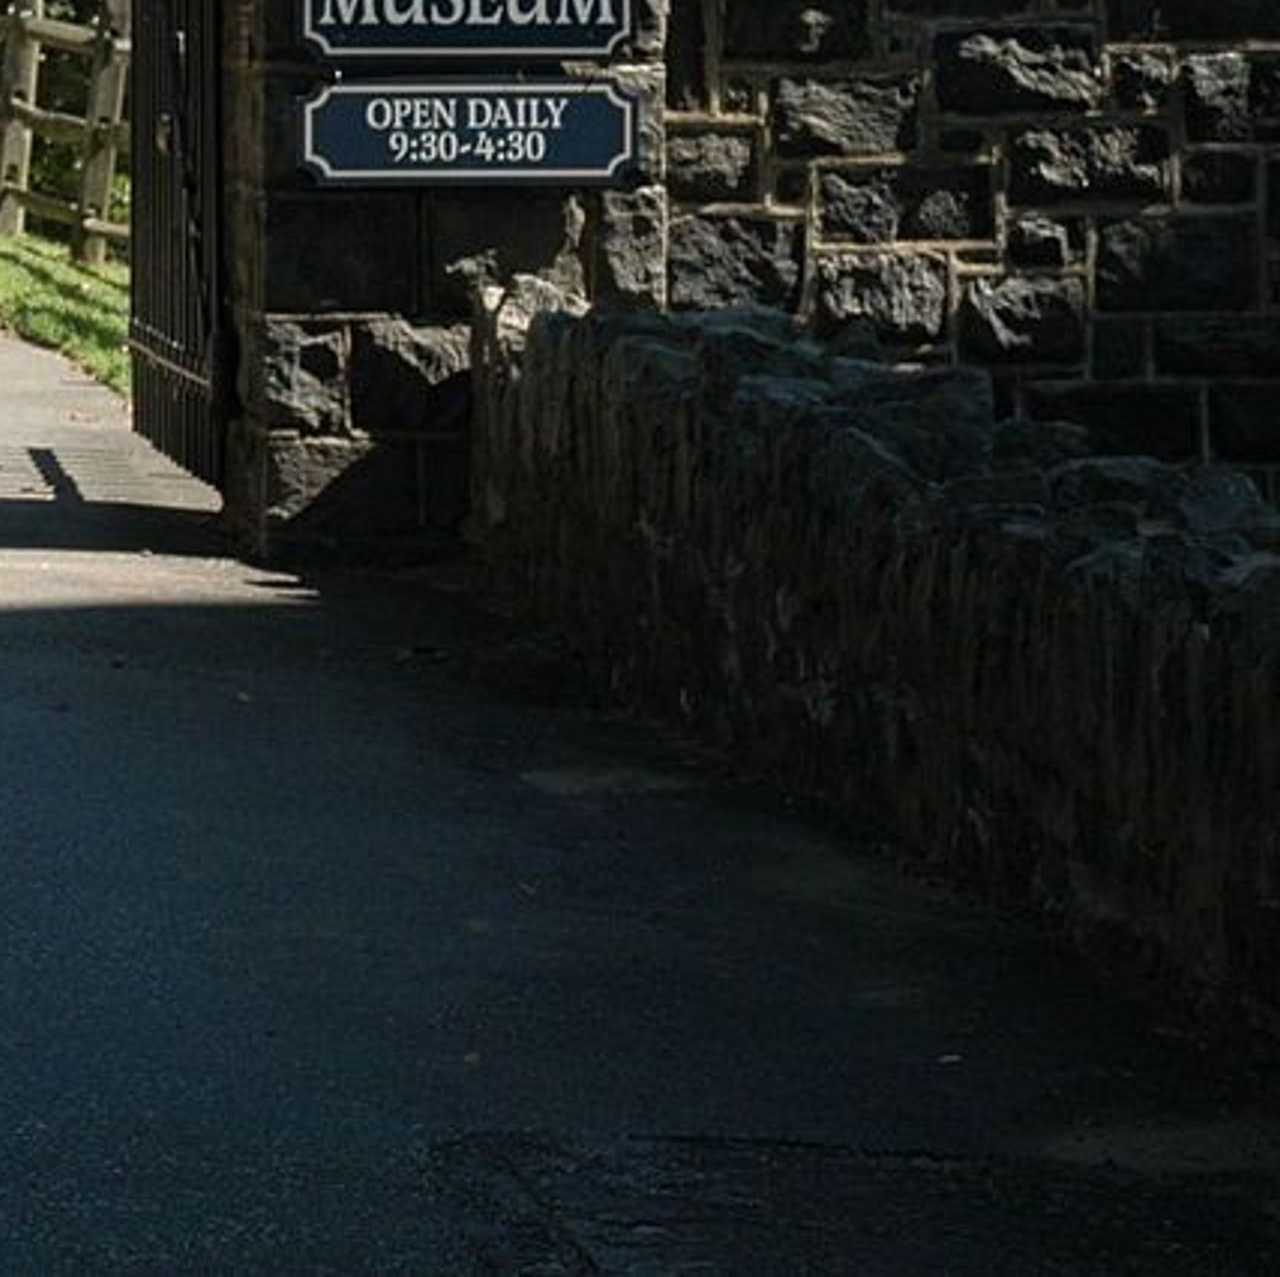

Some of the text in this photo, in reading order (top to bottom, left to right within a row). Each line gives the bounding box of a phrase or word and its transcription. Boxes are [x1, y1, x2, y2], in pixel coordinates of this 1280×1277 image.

[367, 99, 567, 129] OPEN DAILY
[389, 132, 545, 161] 9:30-4:30
